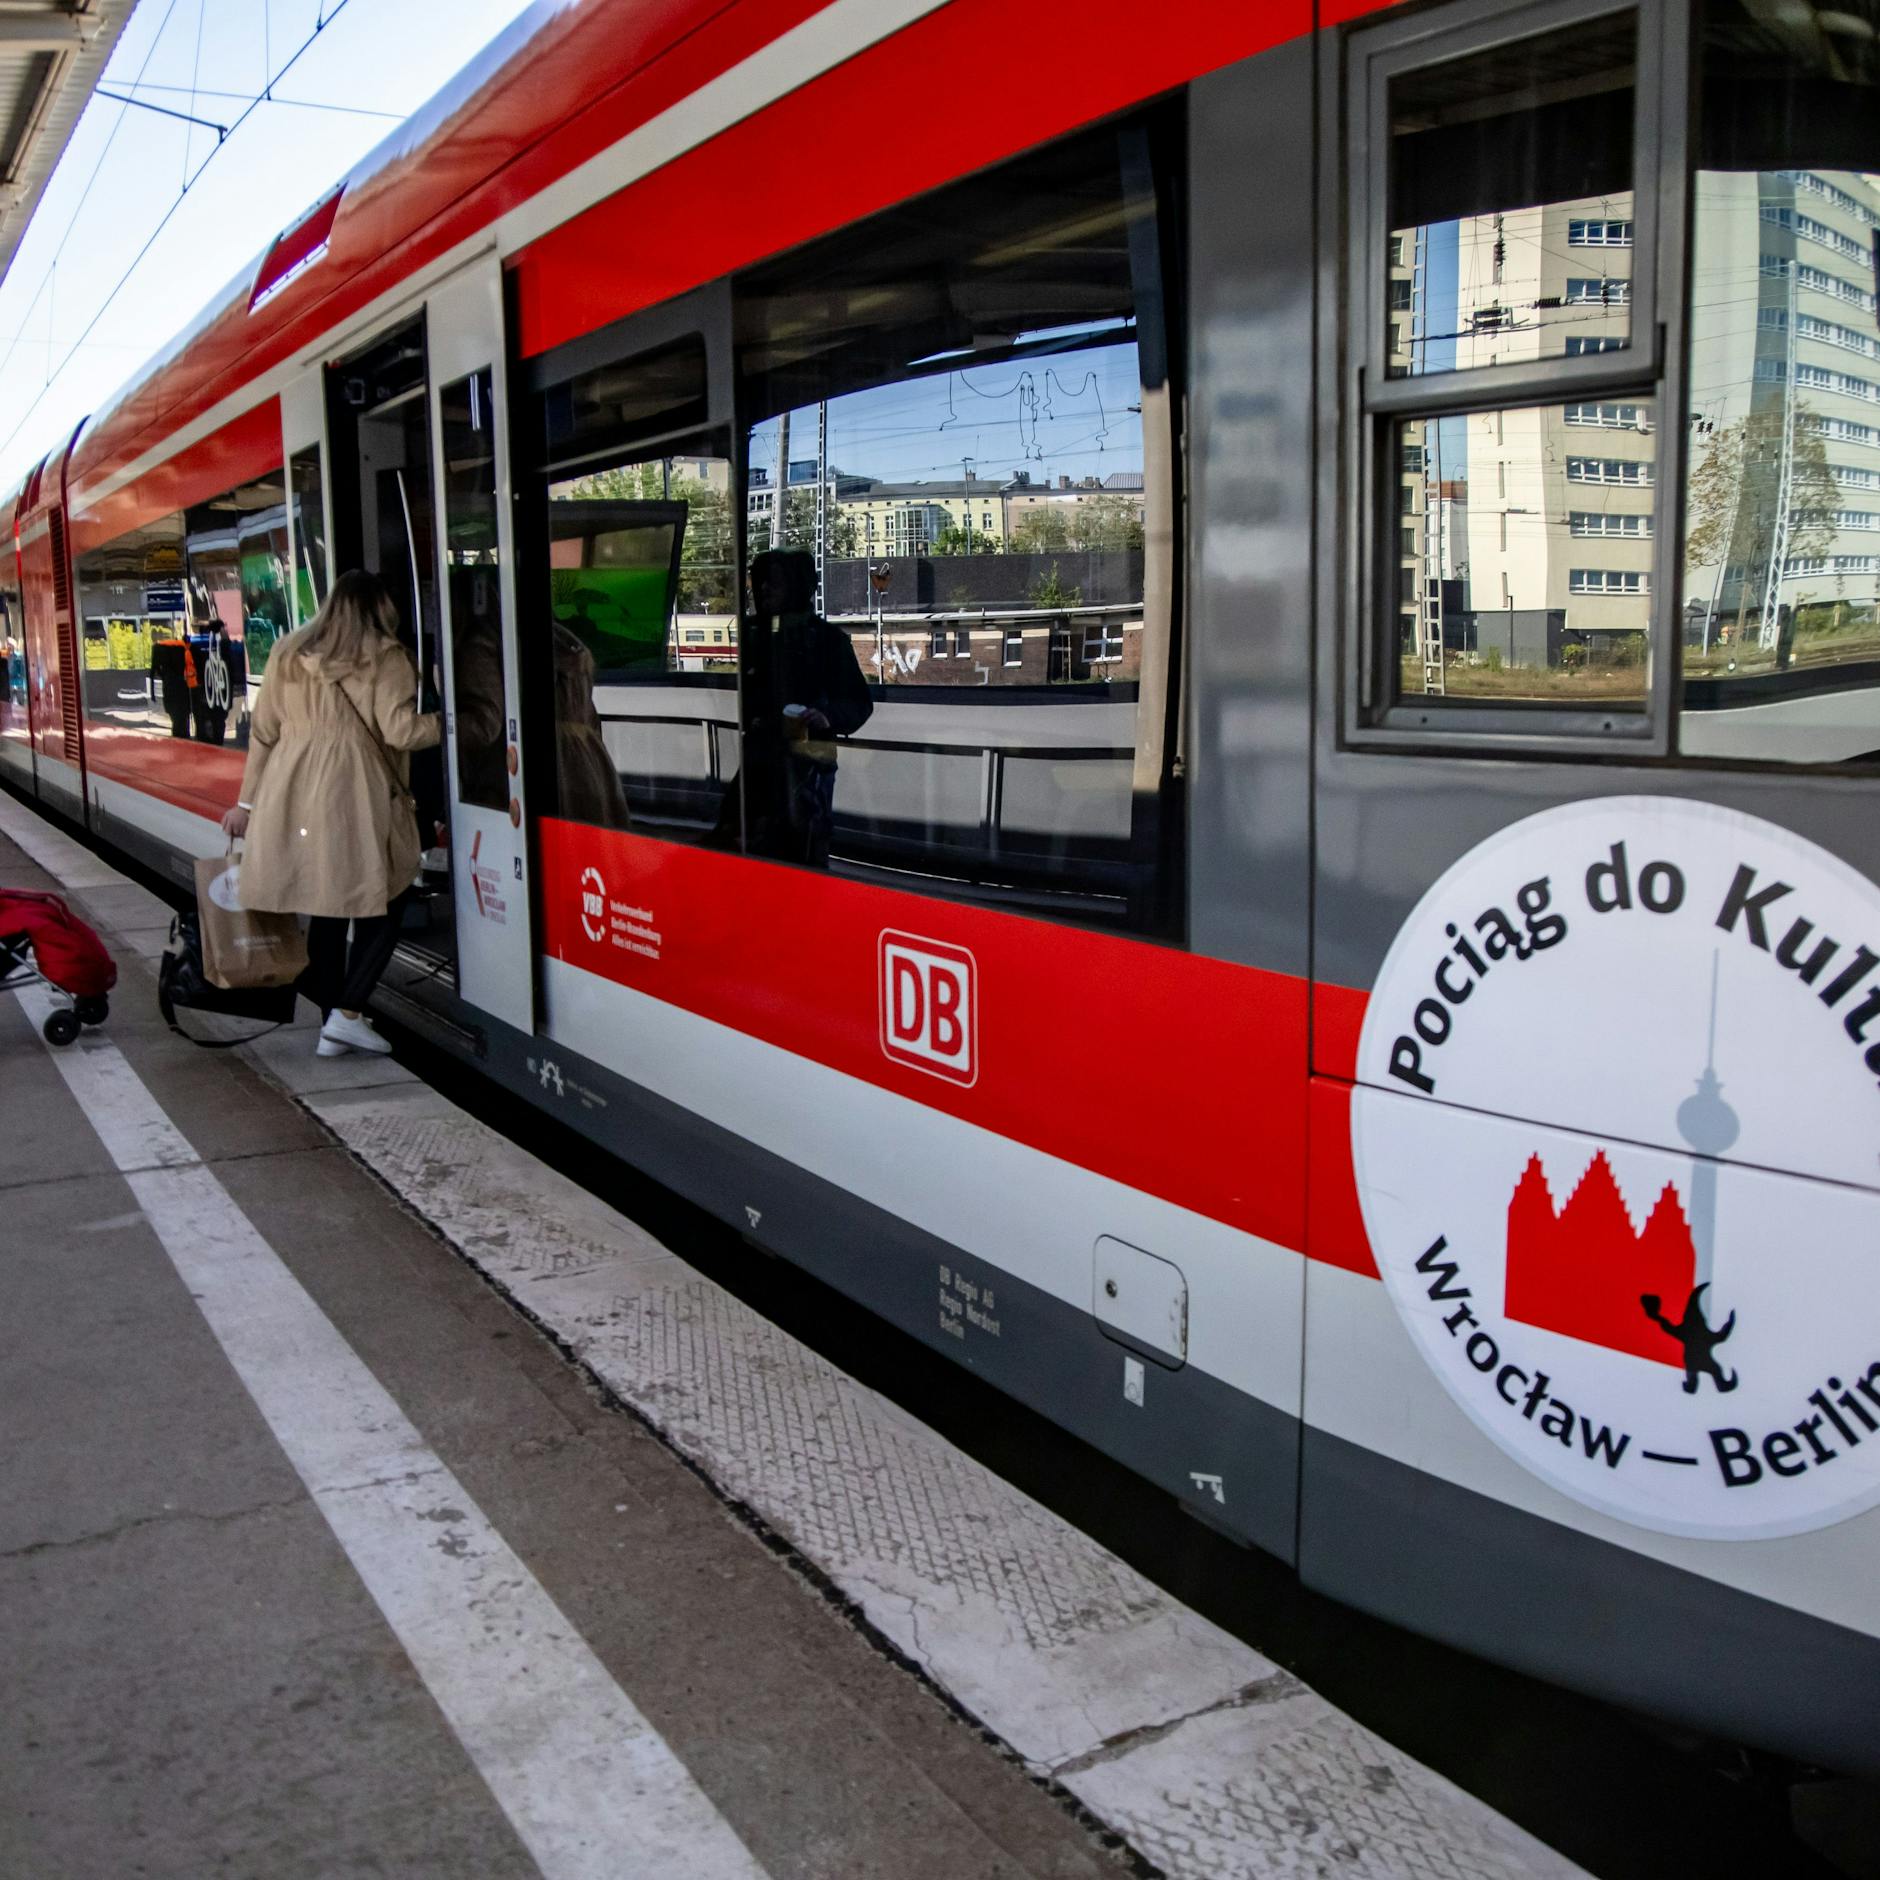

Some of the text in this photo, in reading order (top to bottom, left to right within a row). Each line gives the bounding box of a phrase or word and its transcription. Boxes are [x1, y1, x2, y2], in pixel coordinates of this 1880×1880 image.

[582, 891, 604, 918] VBB
[1388, 839, 1880, 1095] Pociąg do Kult
[892, 953, 963, 1057] DB
[1414, 1234, 1632, 1470] Wrocław
